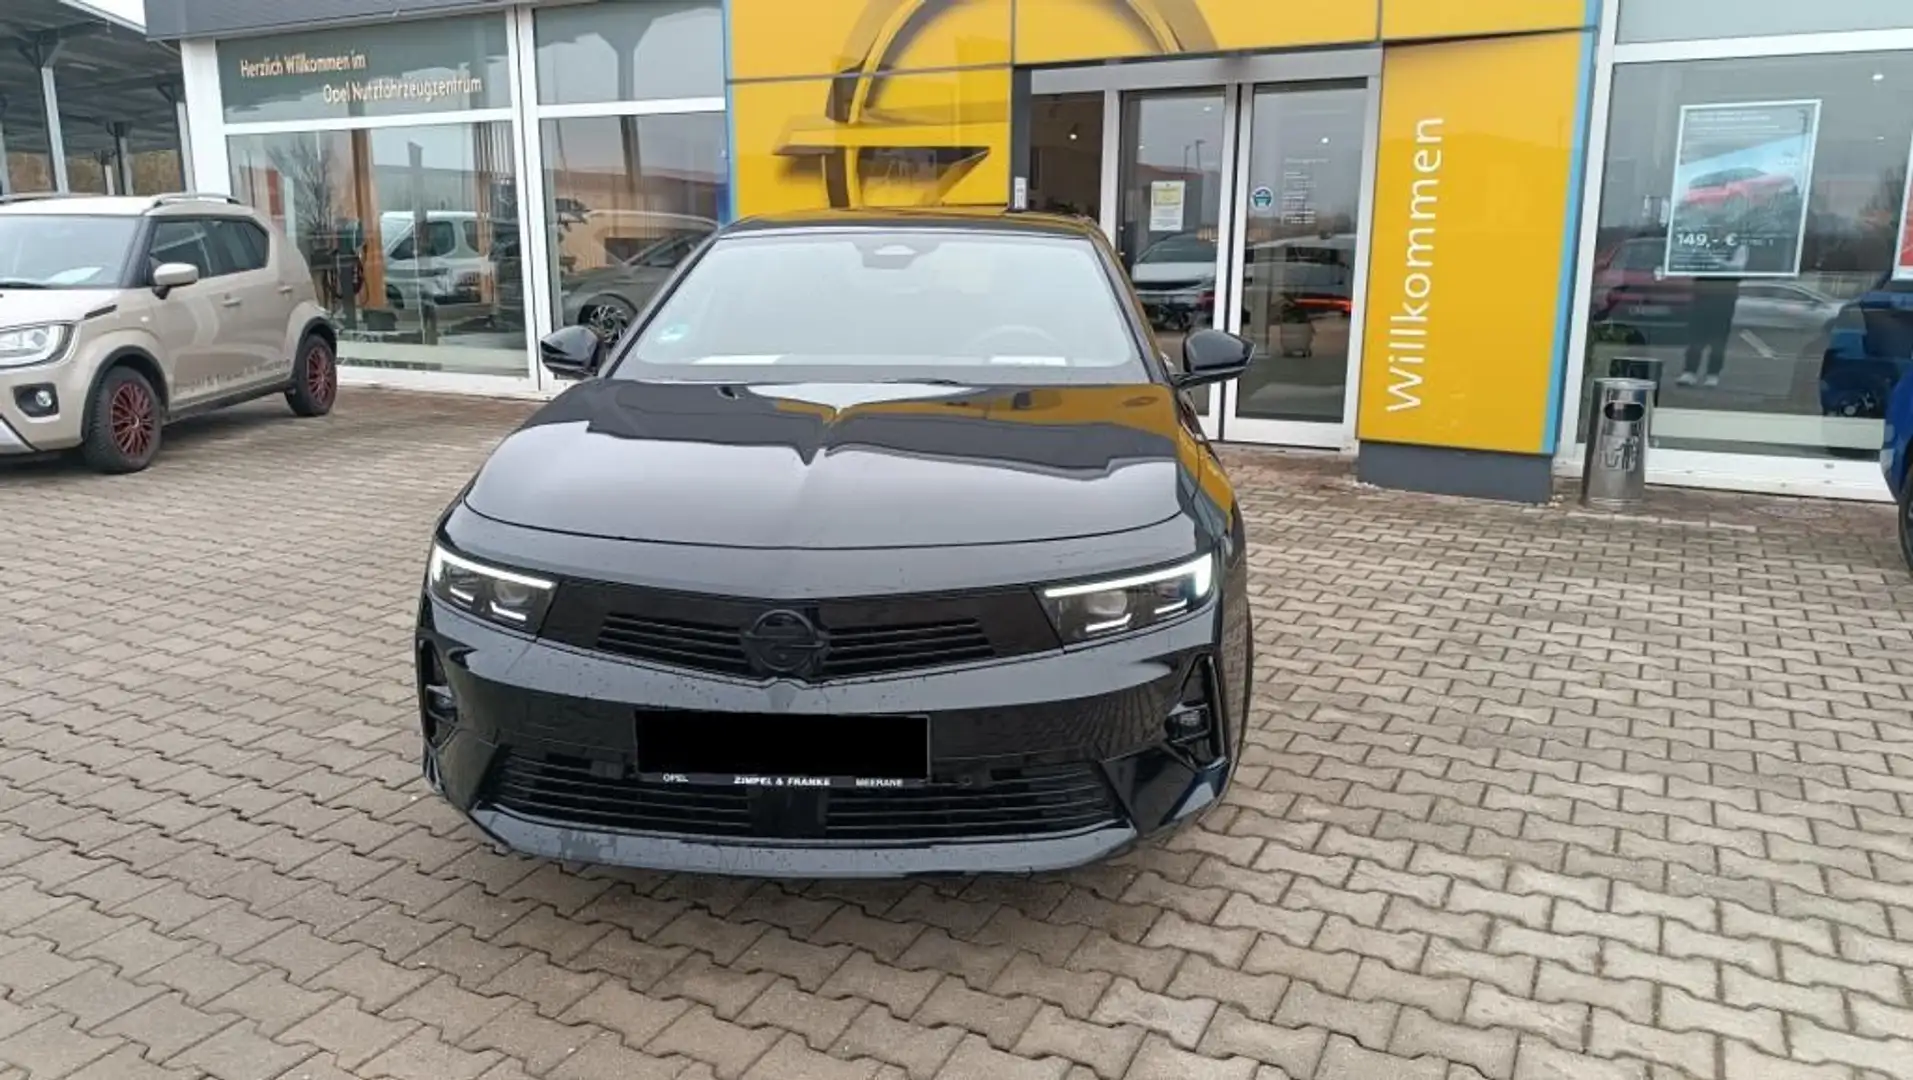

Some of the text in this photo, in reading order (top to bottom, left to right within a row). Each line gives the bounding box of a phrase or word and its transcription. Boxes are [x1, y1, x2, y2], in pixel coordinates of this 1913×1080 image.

[240, 50, 366, 78] Herzlich Willkommen im
[323, 76, 482, 103] Opel Nutzfahrzeugzentrum
[1726, 232, 1739, 246] €
[1386, 116, 1444, 412] Willkommen
[662, 773, 904, 788] OPEL ZIMPEL & FRANKE MEERANE
